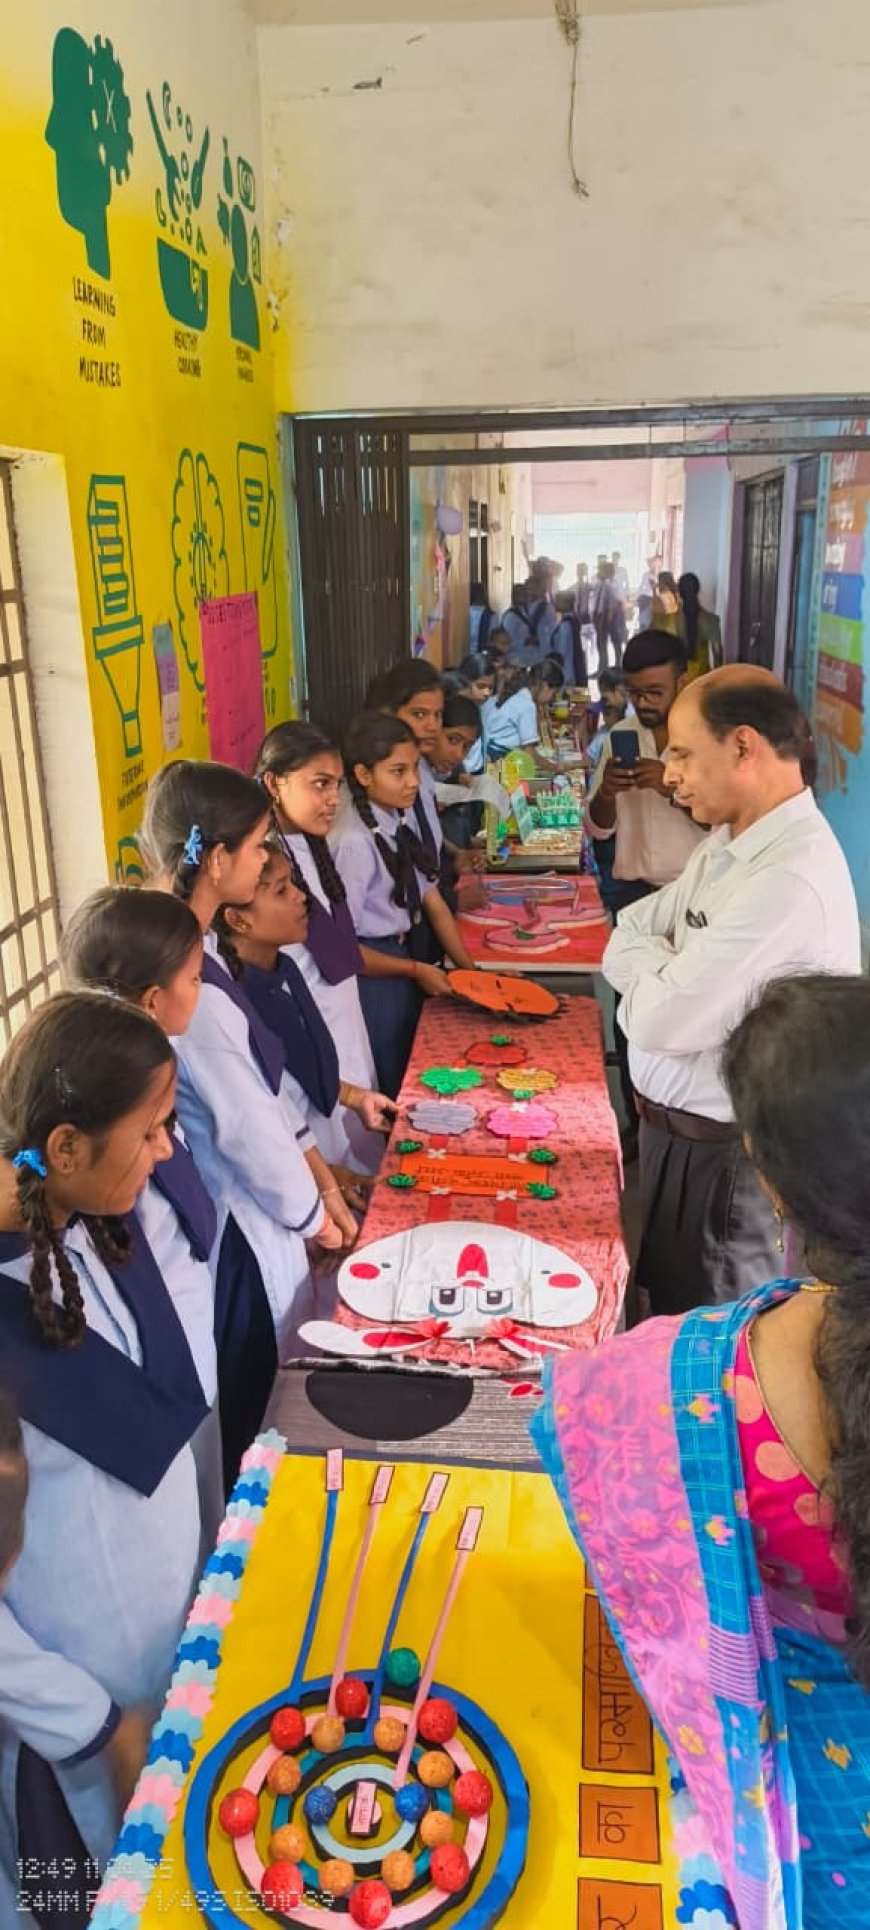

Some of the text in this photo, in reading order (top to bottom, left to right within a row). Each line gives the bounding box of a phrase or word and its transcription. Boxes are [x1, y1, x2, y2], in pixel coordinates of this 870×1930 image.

[72, 276, 116, 318] LEARNING
[82, 318, 106, 349] FROM
[79, 355, 122, 388] MISTAKES
[596, 1800, 635, 1844] का
